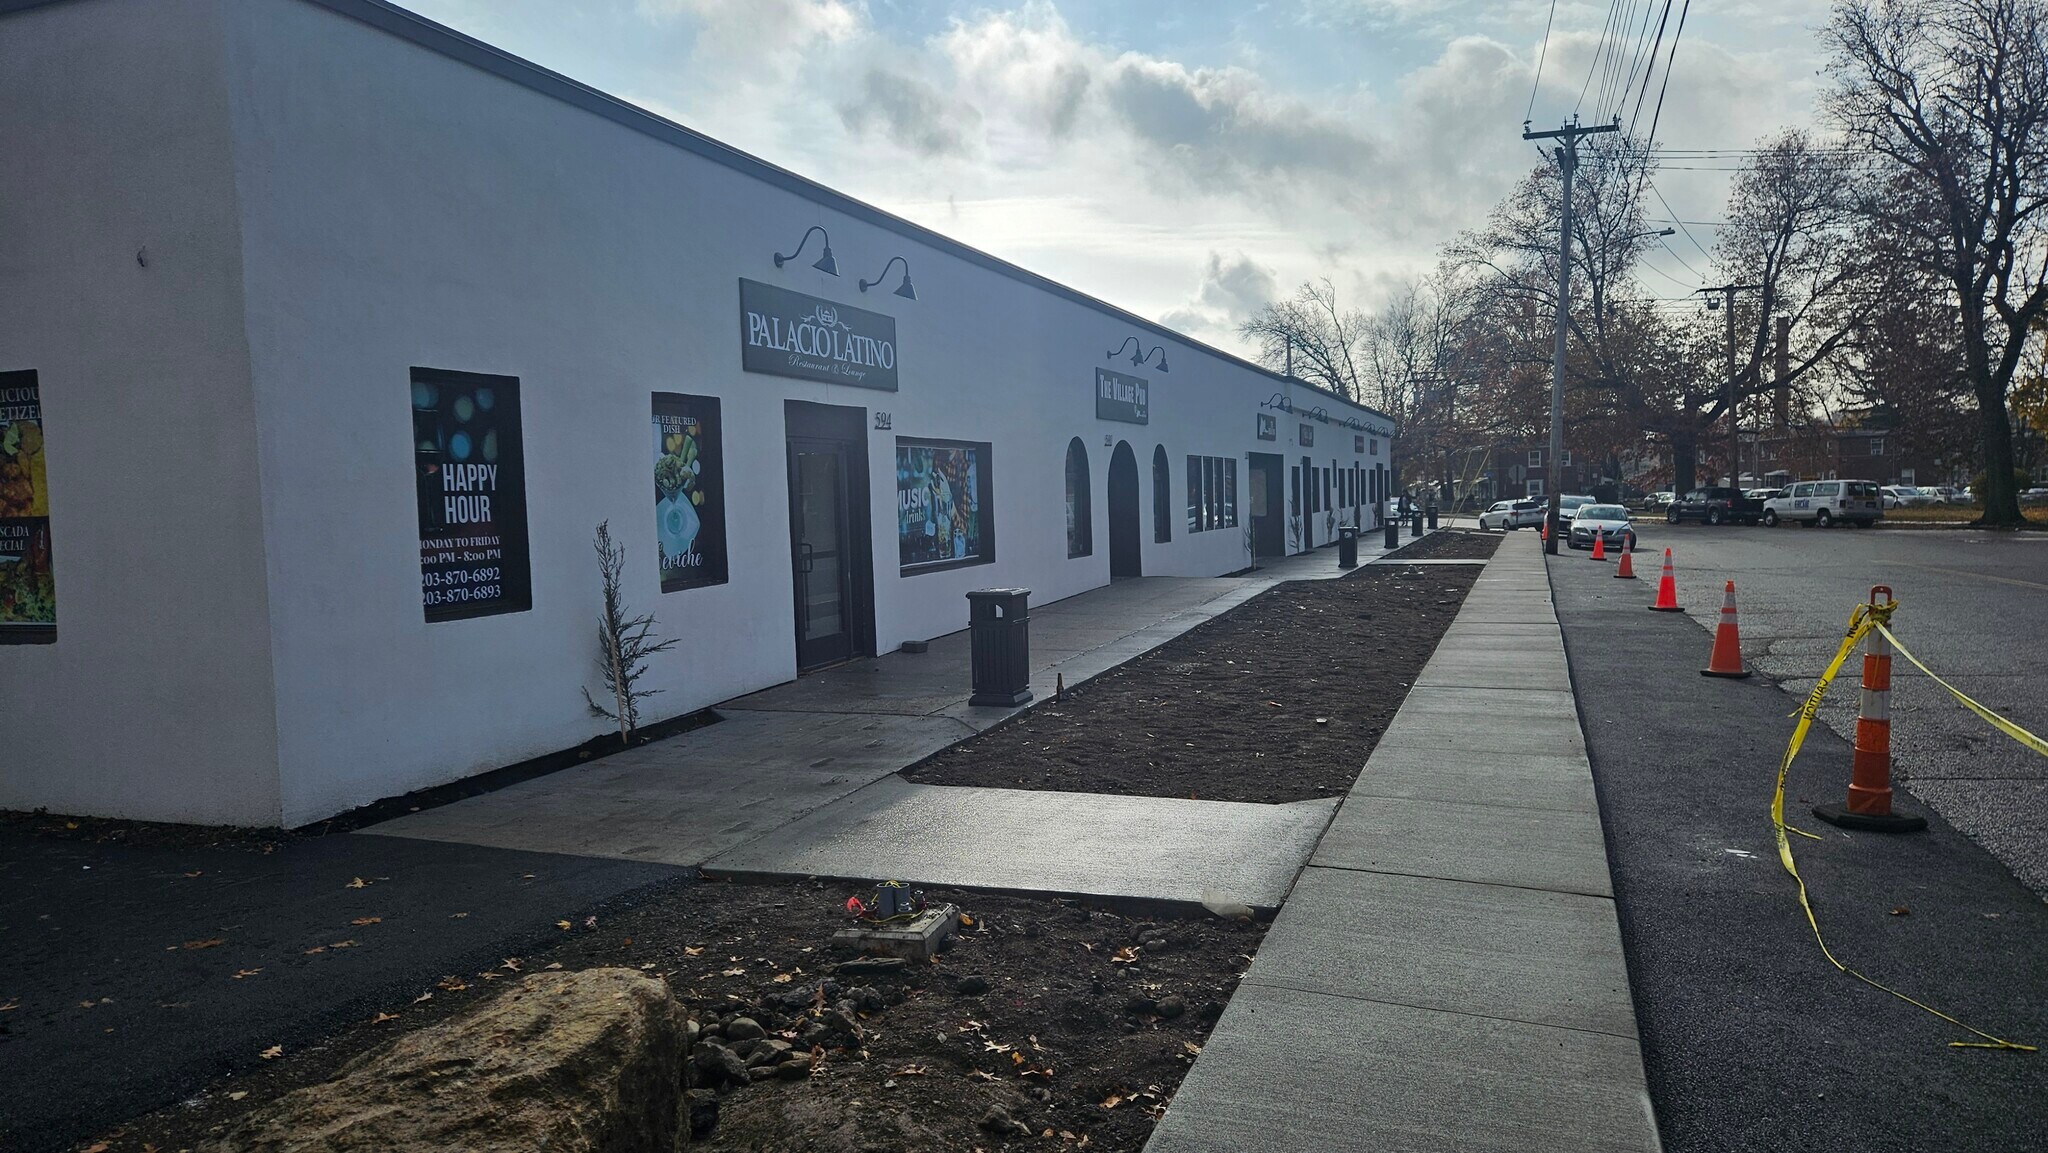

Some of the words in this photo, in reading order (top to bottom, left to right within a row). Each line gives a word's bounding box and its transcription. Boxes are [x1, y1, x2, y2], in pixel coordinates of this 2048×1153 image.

[747, 311, 832, 358] PALACIO
[832, 330, 894, 370] LATINO
[788, 353, 830, 372] Restaurant
[841, 362, 866, 381] Lounge
[1100, 374, 1111, 399] THE
[1112, 377, 1134, 403] VILLAGE
[661, 415, 697, 426] FEATURED
[663, 424, 681, 434] DISH
[875, 411, 891, 429] 594
[442, 463, 498, 492] HAPPY
[444, 495, 492, 524] HOUR
[455, 537, 469, 548] TO
[470, 535, 501, 547] FRIDAY
[438, 552, 455, 563] PM
[463, 550, 485, 562] 8:00
[486, 548, 501, 560] PM
